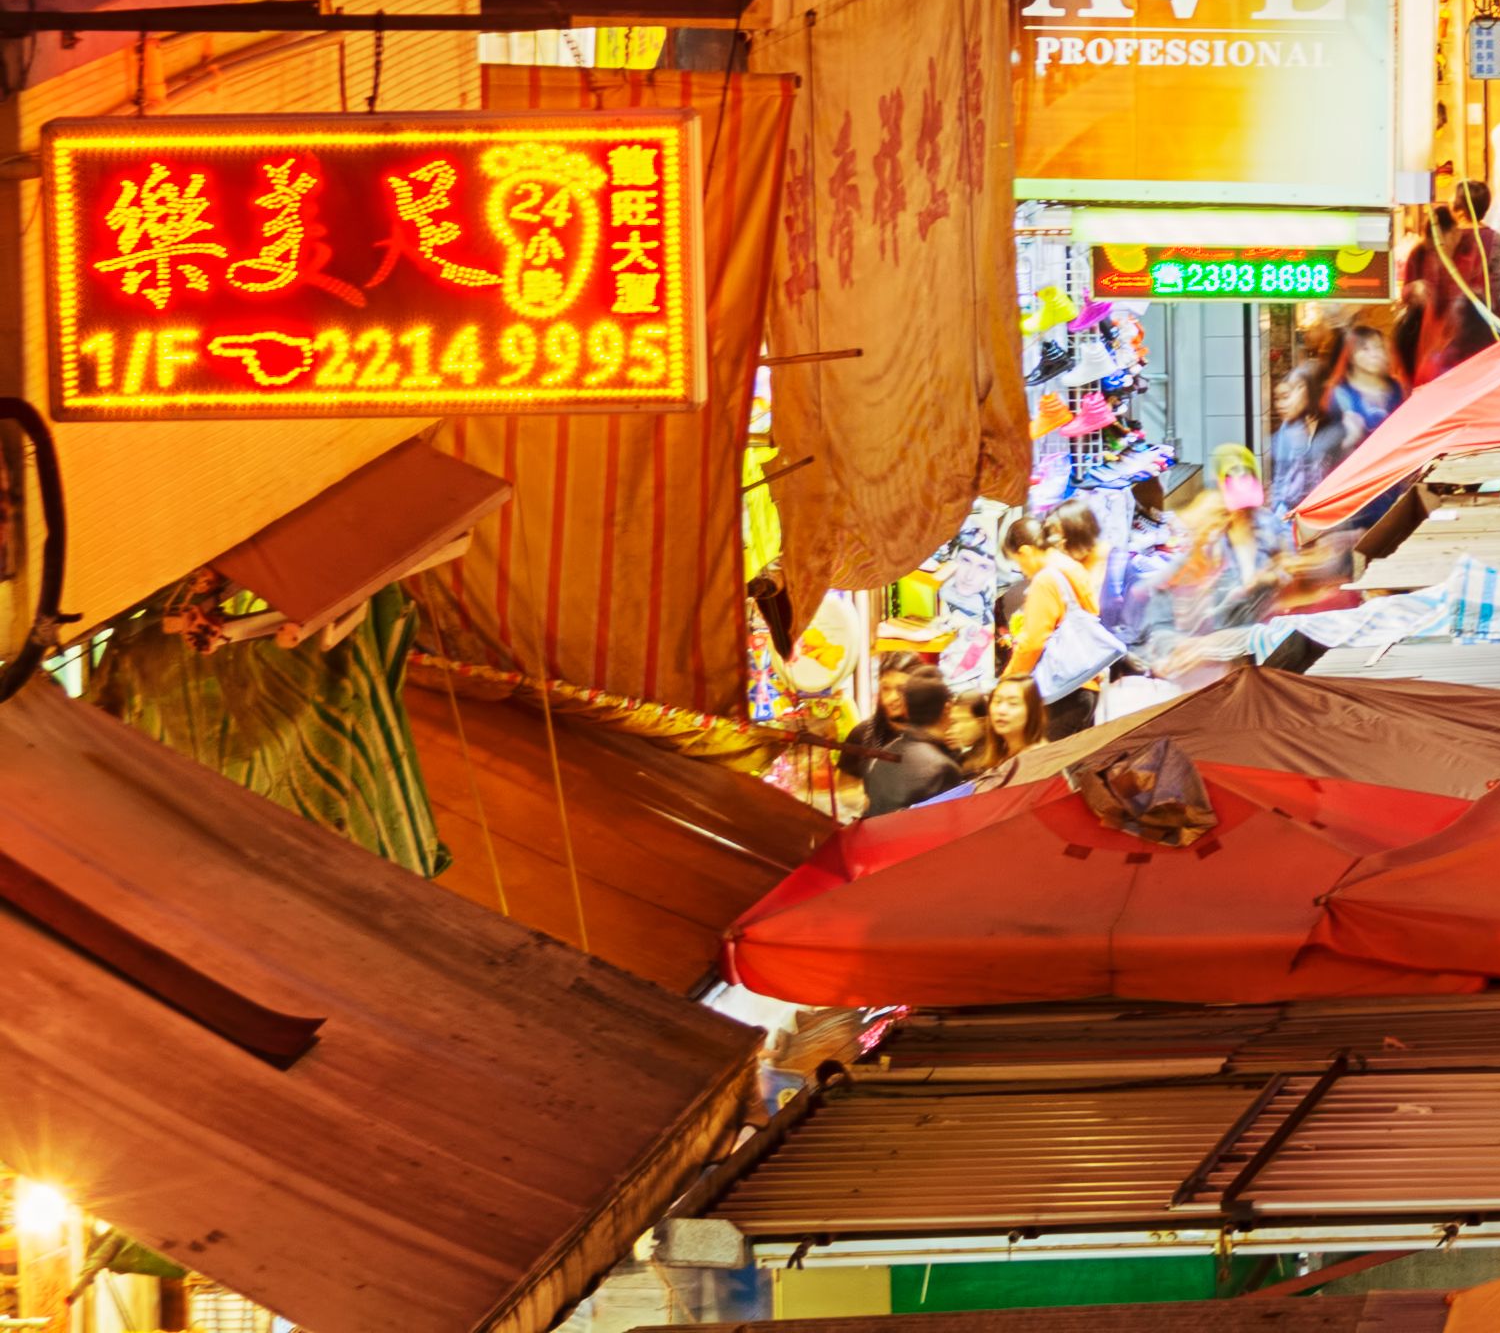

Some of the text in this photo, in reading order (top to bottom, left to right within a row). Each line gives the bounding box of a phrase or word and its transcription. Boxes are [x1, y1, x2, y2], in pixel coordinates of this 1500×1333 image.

[1036, 36, 1333, 69] PROFESSIONAL
[1187, 263, 1330, 294] 2393 8698
[83, 321, 668, 394] 1/F 2214 9995
